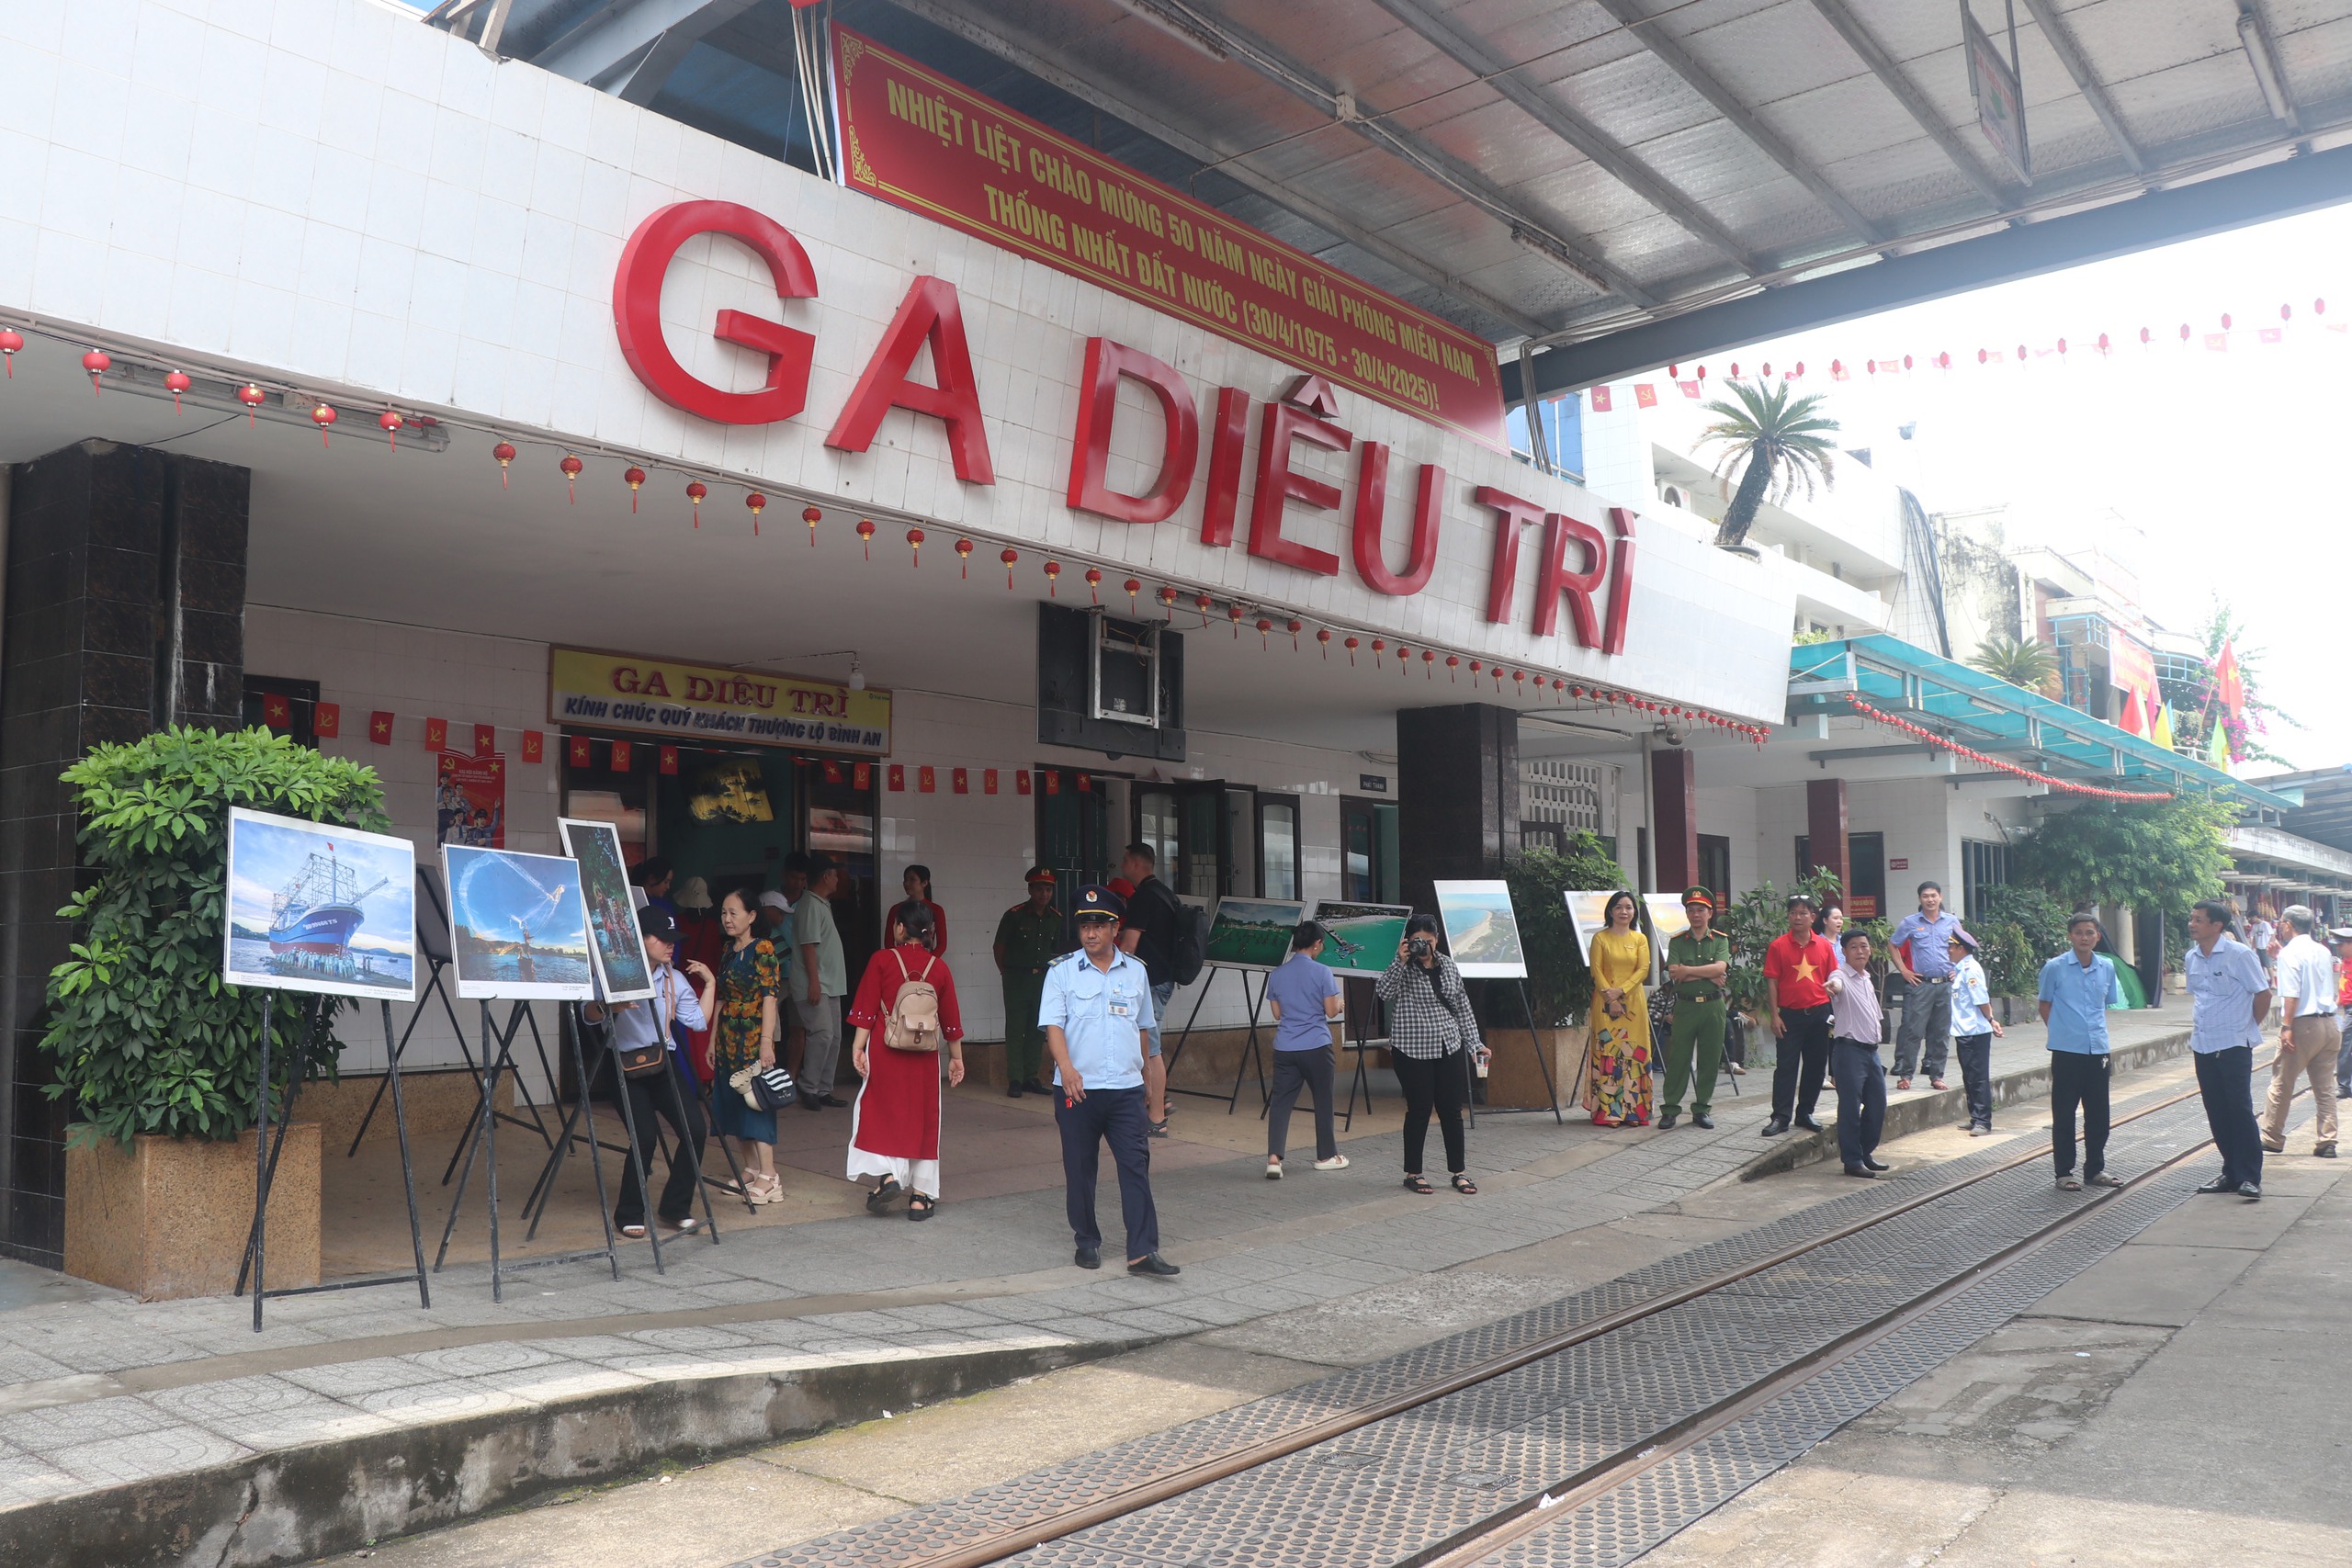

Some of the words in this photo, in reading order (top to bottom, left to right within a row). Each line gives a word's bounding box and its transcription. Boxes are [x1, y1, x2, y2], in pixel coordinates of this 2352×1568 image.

[888, 78, 963, 148] NHIỆT
[971, 119, 1021, 175] LIỆT
[1029, 147, 1092, 204] CHÀO
[1097, 179, 1164, 246] MỪNG
[1168, 213, 1194, 252] 50
[1198, 227, 1246, 276] NĂM
[1249, 251, 1297, 299] NGÀY
[1302, 276, 1339, 317] GIẢI
[1340, 293, 1397, 345] PHÓNG
[1399, 321, 1440, 364] MIỀN
[1441, 343, 1481, 387] NAM,
[984, 184, 1068, 251] THỐNG
[1070, 222, 1131, 279] NHẤT
[1136, 250, 1177, 298] ĐẤT
[1182, 272, 1238, 323] NƯỚC
[1242, 300, 1338, 367] (30/4/1975
[1351, 347, 1440, 412] 30/4/2025)!
[613, 198, 995, 486] GA
[1067, 335, 1446, 597] DIÊU
[1474, 485, 1636, 656] TRÌ
[564, 694, 609, 718] KÍNH
[612, 702, 656, 724] CHÚC
[660, 705, 693, 727] QUÝ
[693, 711, 745, 732] KHÁCH
[748, 716, 806, 740] THƯỢNG
[808, 719, 825, 742] LỘ
[829, 721, 861, 745] BÌNH
[863, 731, 883, 747] AN
[611, 666, 672, 698] GA
[789, 687, 851, 719] TRÌ
